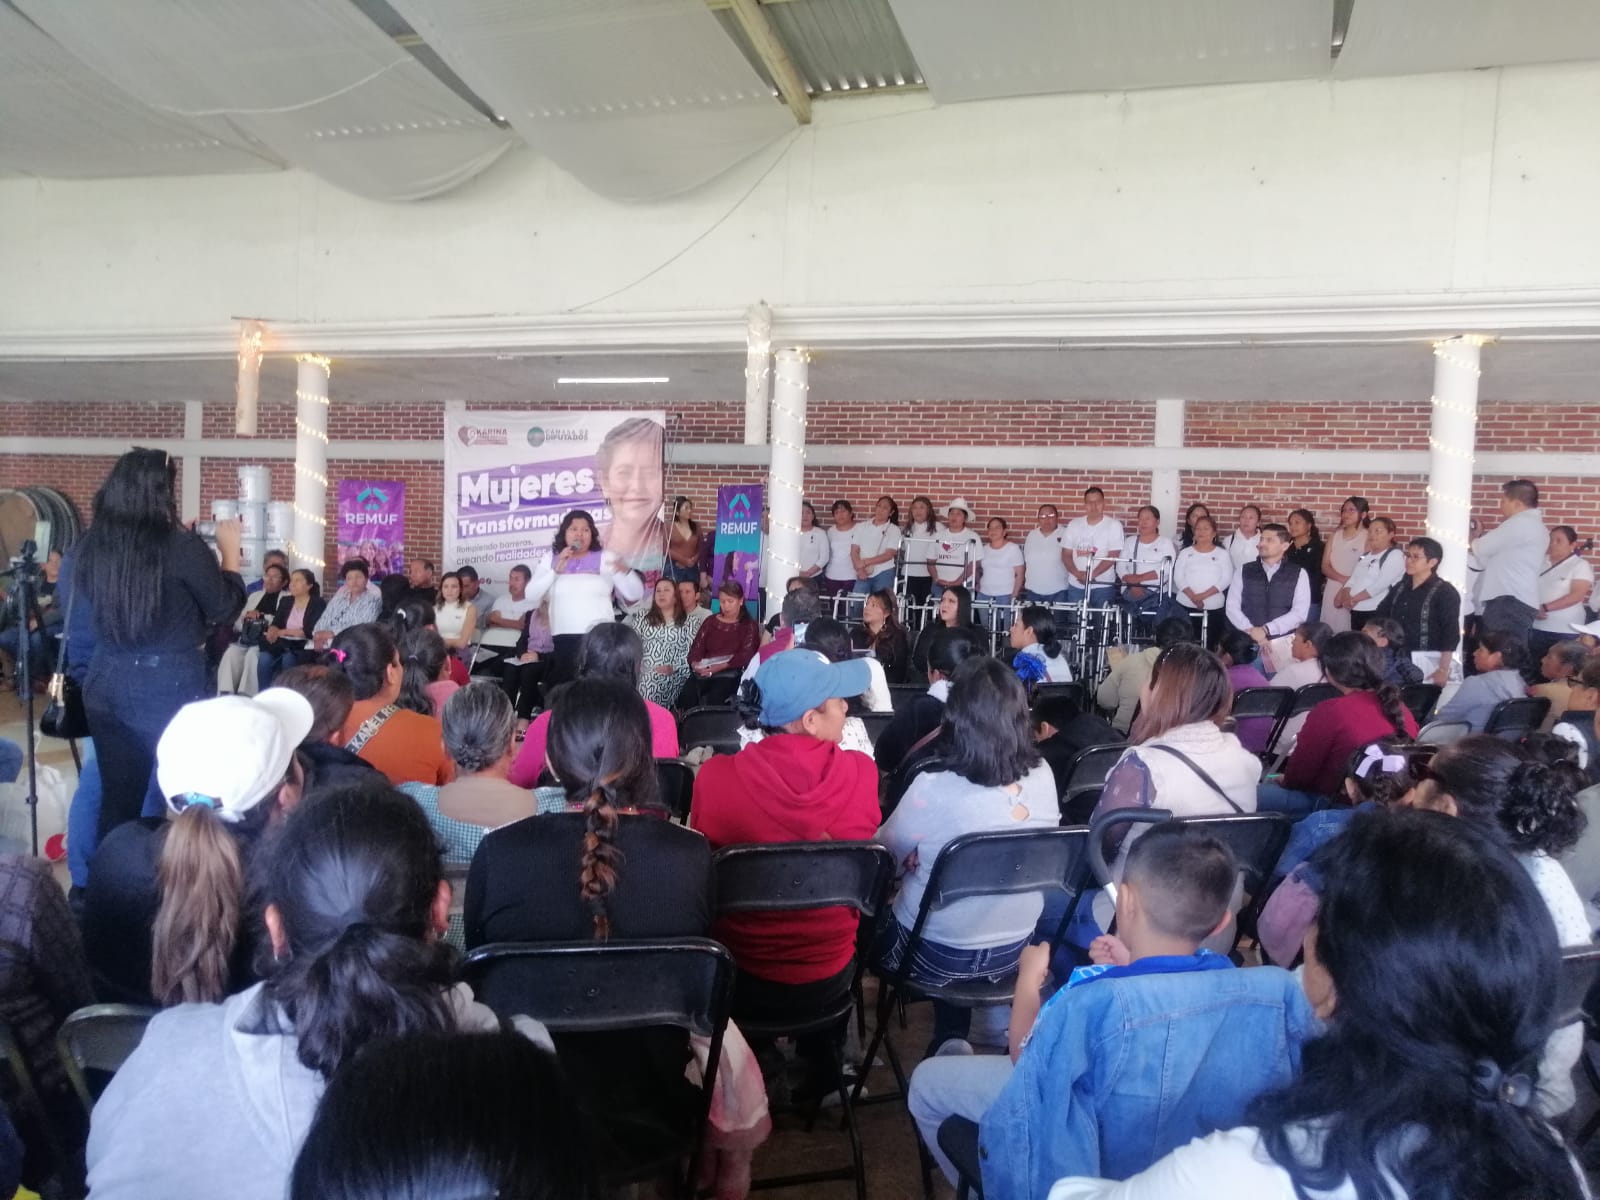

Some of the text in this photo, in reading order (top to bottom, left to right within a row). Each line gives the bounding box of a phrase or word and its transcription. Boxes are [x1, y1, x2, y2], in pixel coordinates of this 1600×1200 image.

[461, 464, 595, 511] Mujeres
[345, 512, 398, 525] REMUF
[720, 521, 758, 535] REMUF
[456, 542, 498, 553] Rompiendo
[456, 553, 494, 565] creando
